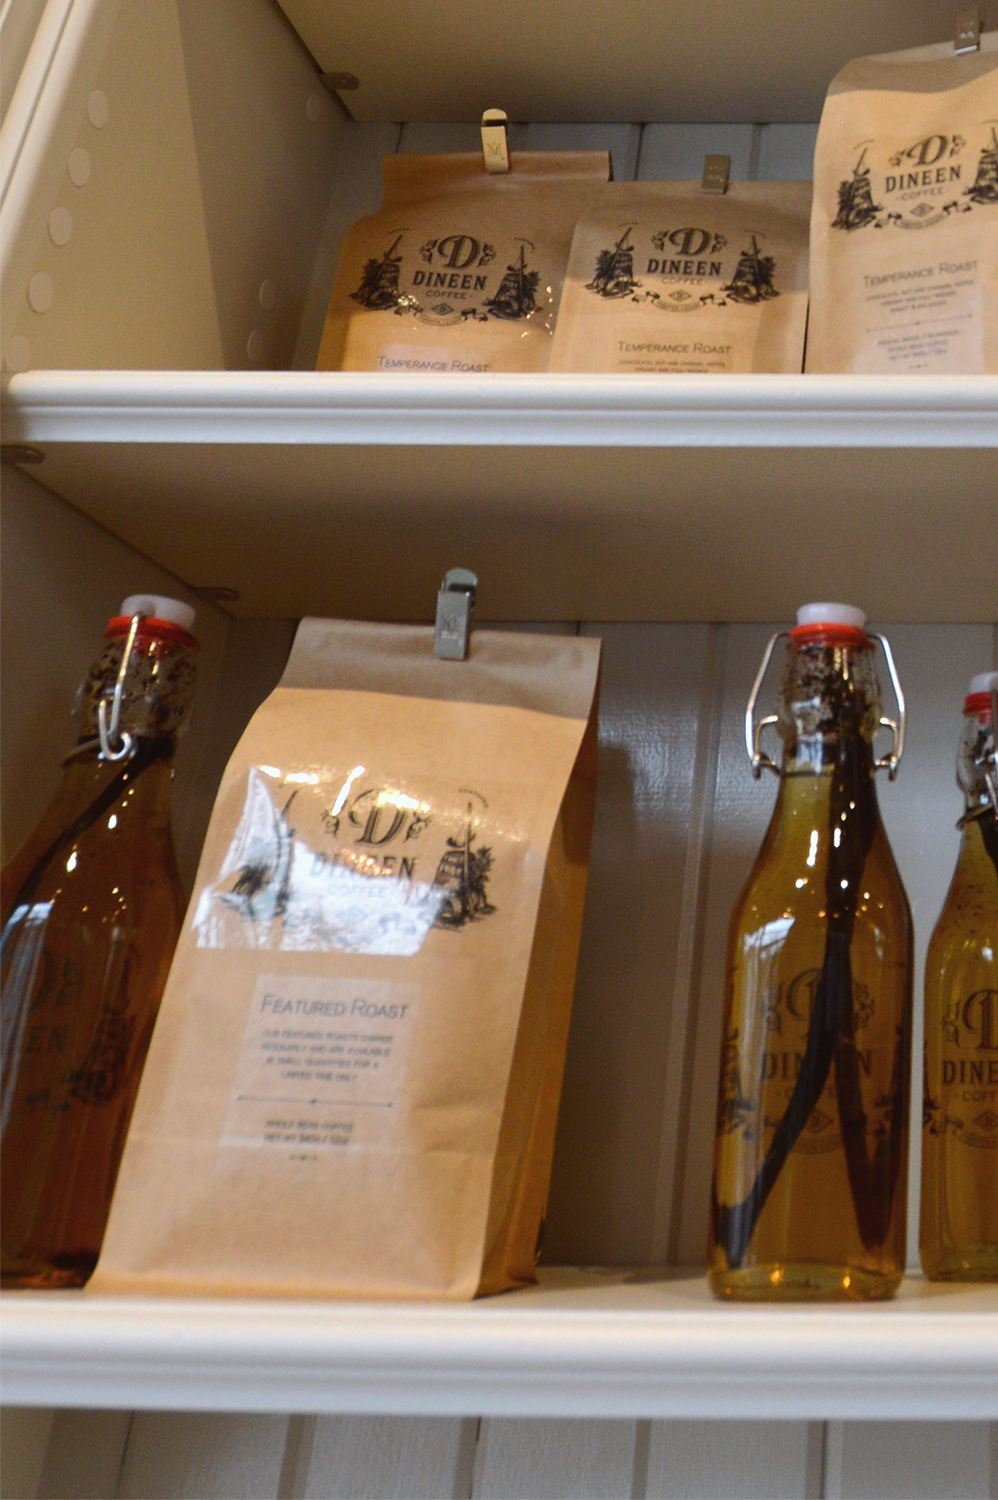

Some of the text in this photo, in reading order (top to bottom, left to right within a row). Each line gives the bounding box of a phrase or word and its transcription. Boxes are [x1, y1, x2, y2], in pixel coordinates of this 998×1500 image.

[906, 135, 949, 167] D
[884, 165, 962, 193] DINEEN
[901, 187, 944, 200] COFFEE
[668, 227, 711, 257] D
[437, 234, 481, 270] D
[647, 258, 723, 276] DINEEN
[412, 270, 488, 291] DINEEN
[661, 276, 703, 286] COFFEE
[425, 290, 466, 300] COFFEE
[618, 341, 732, 355] TEMPERANCE ROAST
[378, 356, 490, 373] TEMPERANCE ROAST
[260, 993, 409, 1020] FEATURED ROAST
